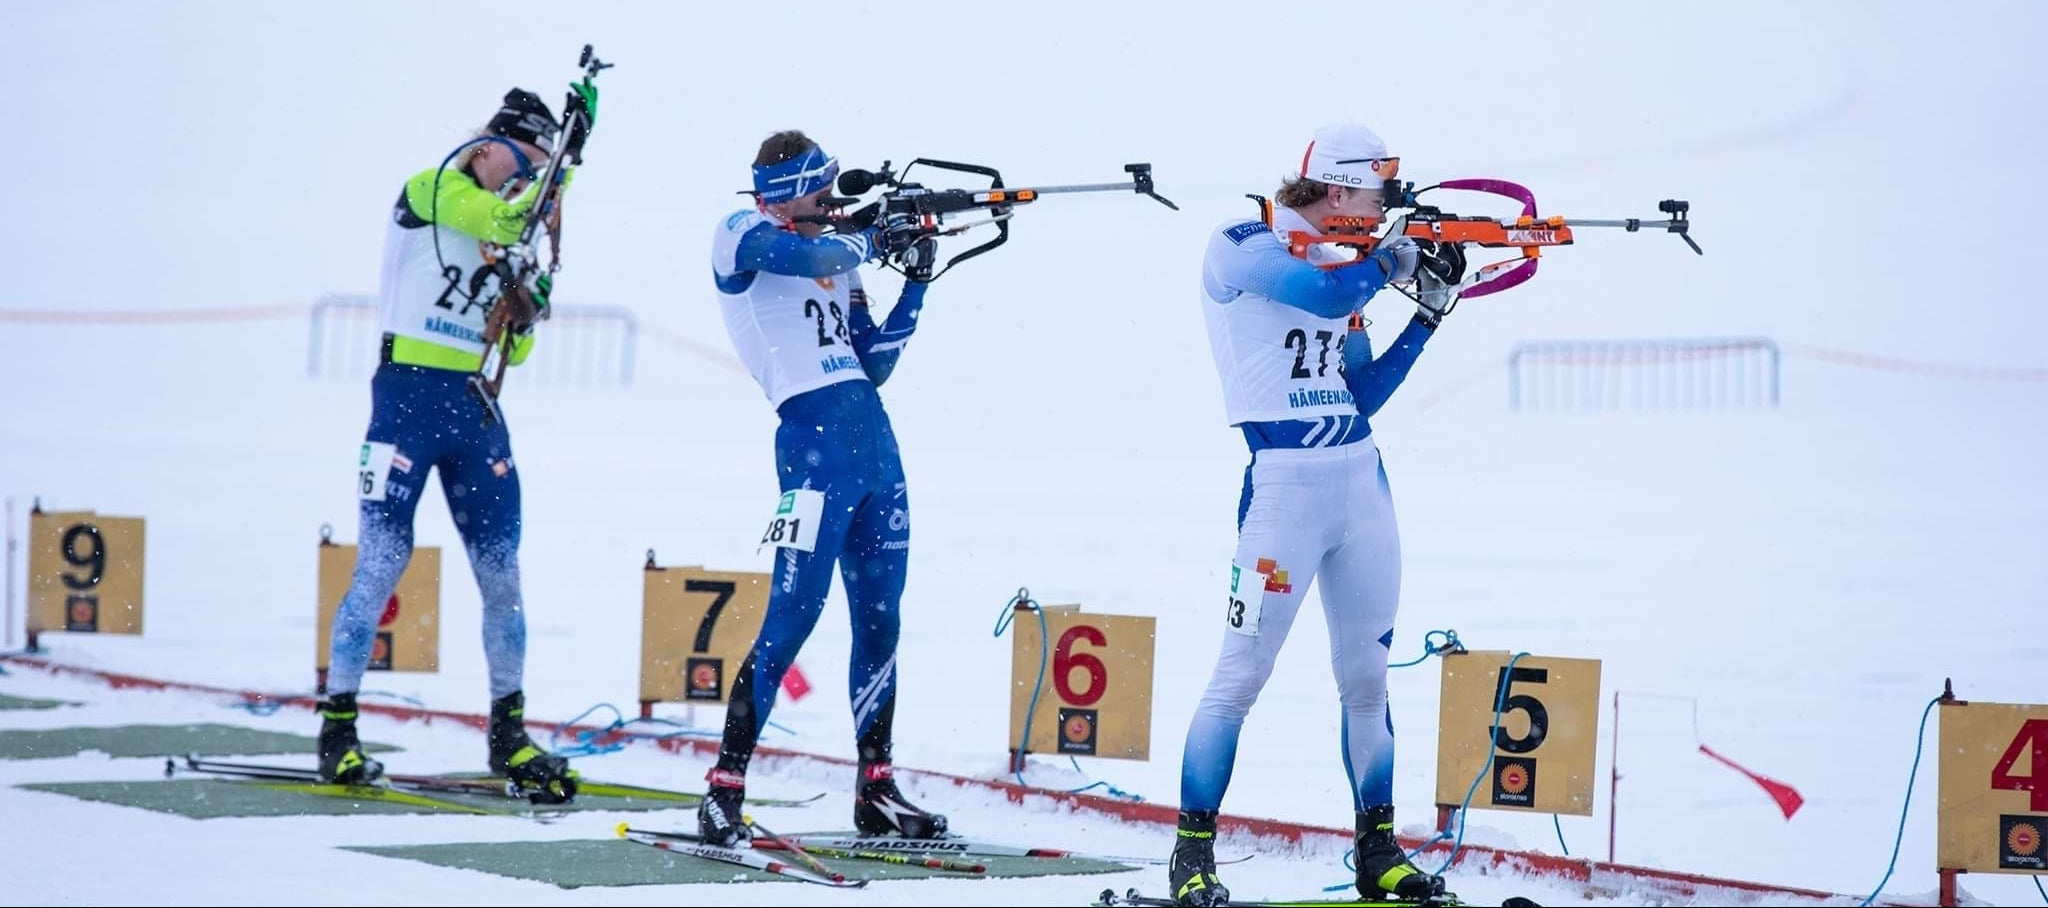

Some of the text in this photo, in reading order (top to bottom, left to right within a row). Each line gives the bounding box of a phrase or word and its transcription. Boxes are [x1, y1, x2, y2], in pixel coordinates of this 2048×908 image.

[1322, 173, 1362, 185] odlo
[804, 298, 851, 348] 28
[61, 524, 106, 591] 9
[684, 579, 736, 653] 7
[1053, 624, 1107, 707] 6
[1488, 666, 1549, 753] 5
[1991, 719, 2048, 812] 4
[851, 840, 969, 851] MADSHUS
